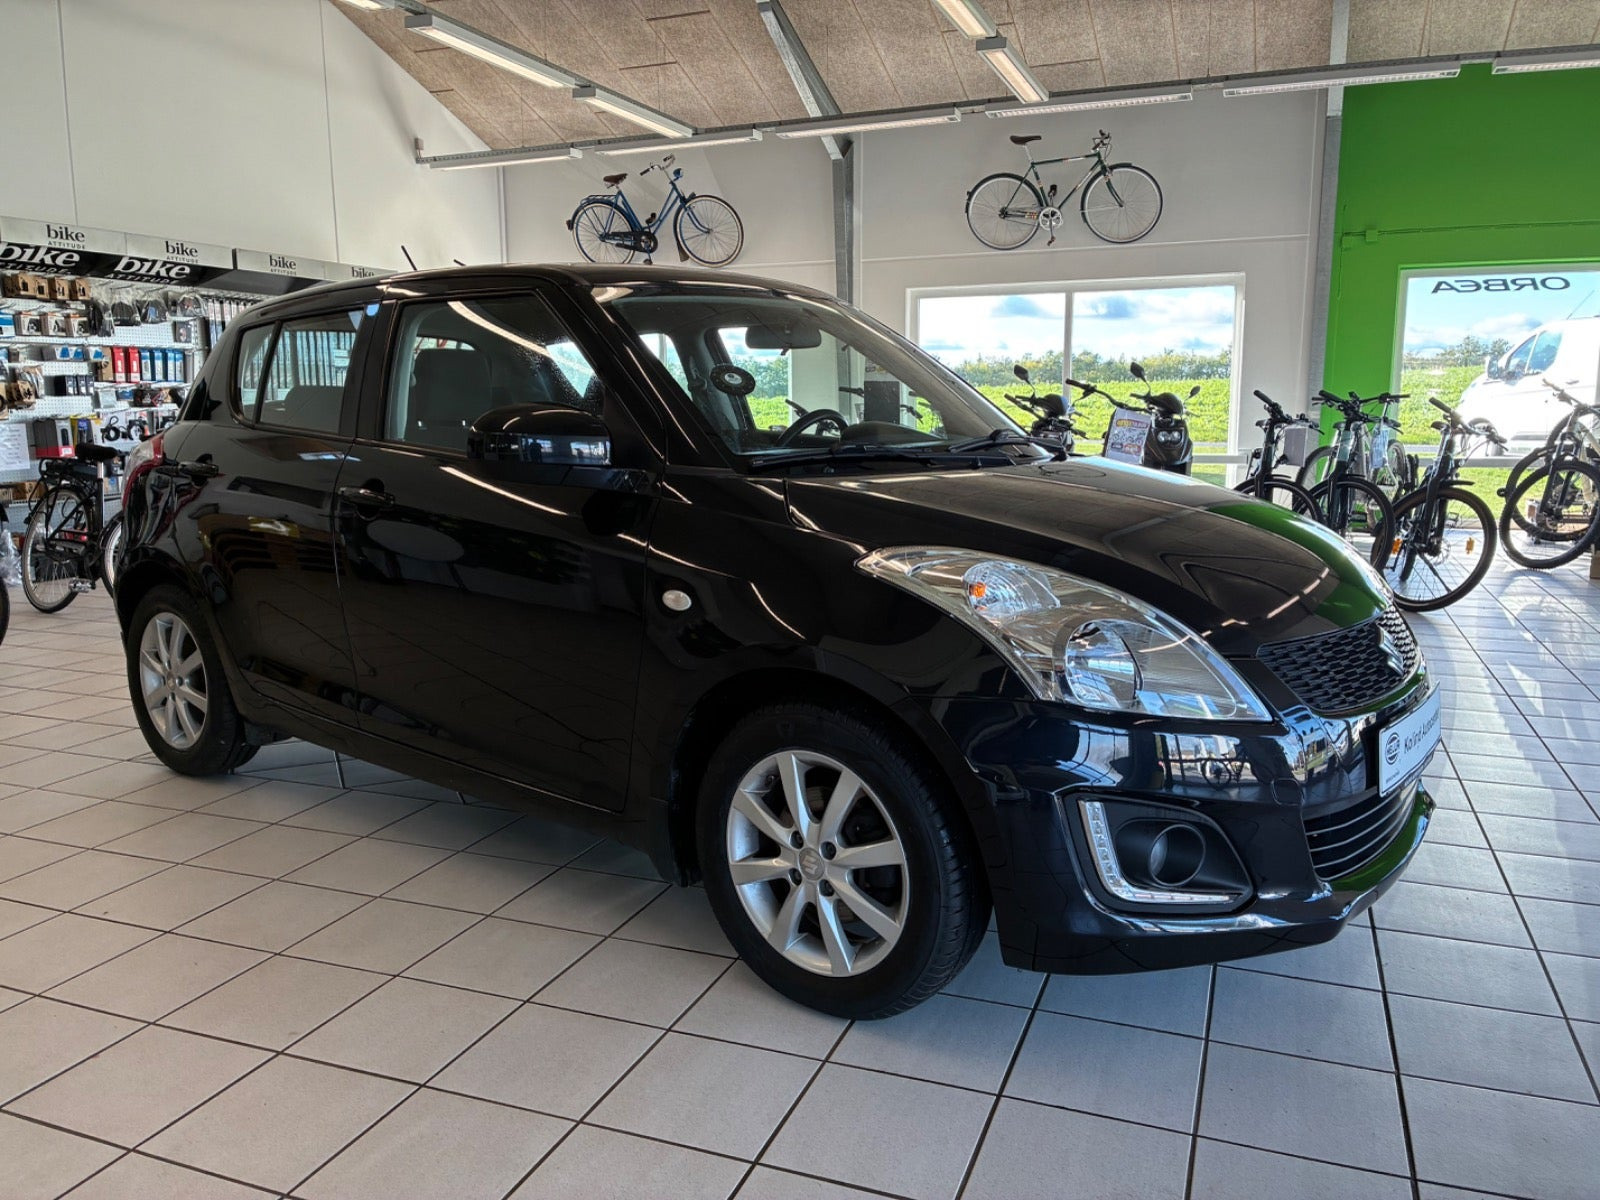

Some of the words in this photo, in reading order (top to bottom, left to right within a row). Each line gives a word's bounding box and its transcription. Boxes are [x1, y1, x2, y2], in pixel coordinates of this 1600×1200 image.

[46, 224, 86, 243] bike
[48, 240, 86, 250] ATTITUDE
[165, 240, 199, 257] bike
[0, 241, 81, 268] bike
[269, 254, 297, 270] bike
[113, 256, 191, 280] bike
